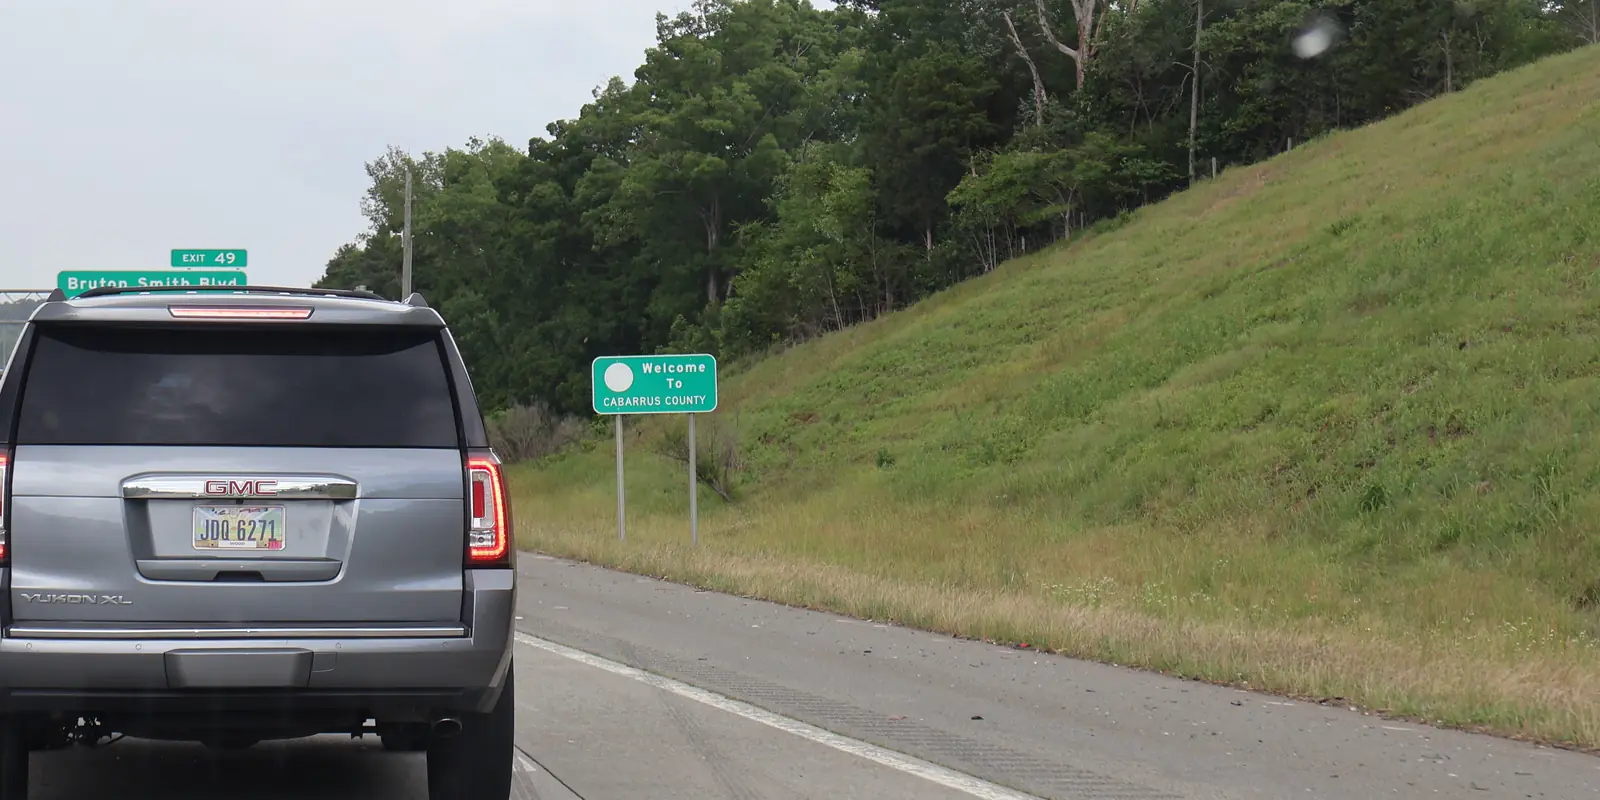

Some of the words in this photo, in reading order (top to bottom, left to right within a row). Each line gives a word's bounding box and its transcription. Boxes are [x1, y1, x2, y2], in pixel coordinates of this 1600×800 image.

[182, 254, 205, 262] EXIT
[214, 252, 236, 264] 49
[68, 277, 128, 289] Bruton
[138, 277, 190, 287] Smith
[200, 277, 237, 287] Blvd
[642, 362, 706, 374] Welcome
[666, 378, 683, 389] To
[603, 396, 661, 407] CABARRUS
[665, 395, 706, 406] COUNTY
[205, 480, 278, 496] GMC
[200, 519, 230, 541] JDQ
[237, 519, 277, 541] 6271
[21, 593, 97, 604] YUKON
[101, 595, 133, 605] XL
